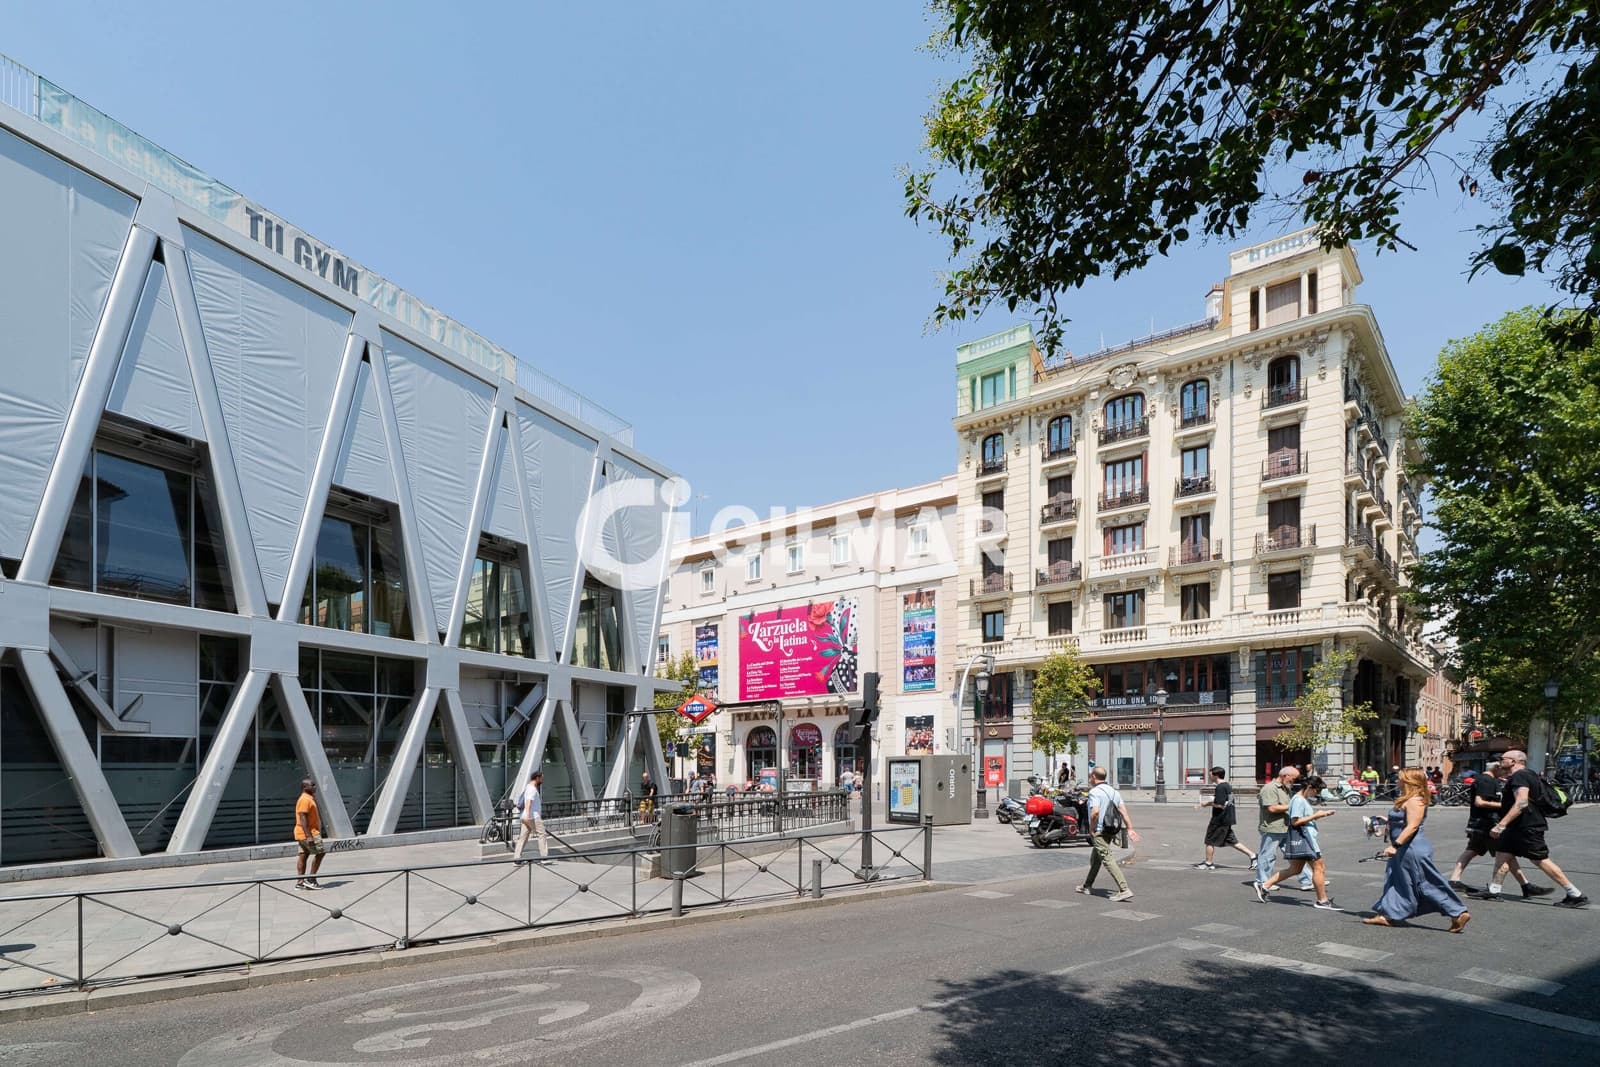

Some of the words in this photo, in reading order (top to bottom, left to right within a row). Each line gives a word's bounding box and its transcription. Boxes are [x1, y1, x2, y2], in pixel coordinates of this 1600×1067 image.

[294, 237, 358, 297] GYM
[748, 618, 808, 652] Zarzuela
[779, 635, 808, 657] Latina
[1102, 696, 1127, 706] TENIDO
[1131, 695, 1145, 704] UNA
[1149, 695, 1158, 703] ID
[797, 708, 814, 718] LA
[1108, 722, 1153, 731] Santander
